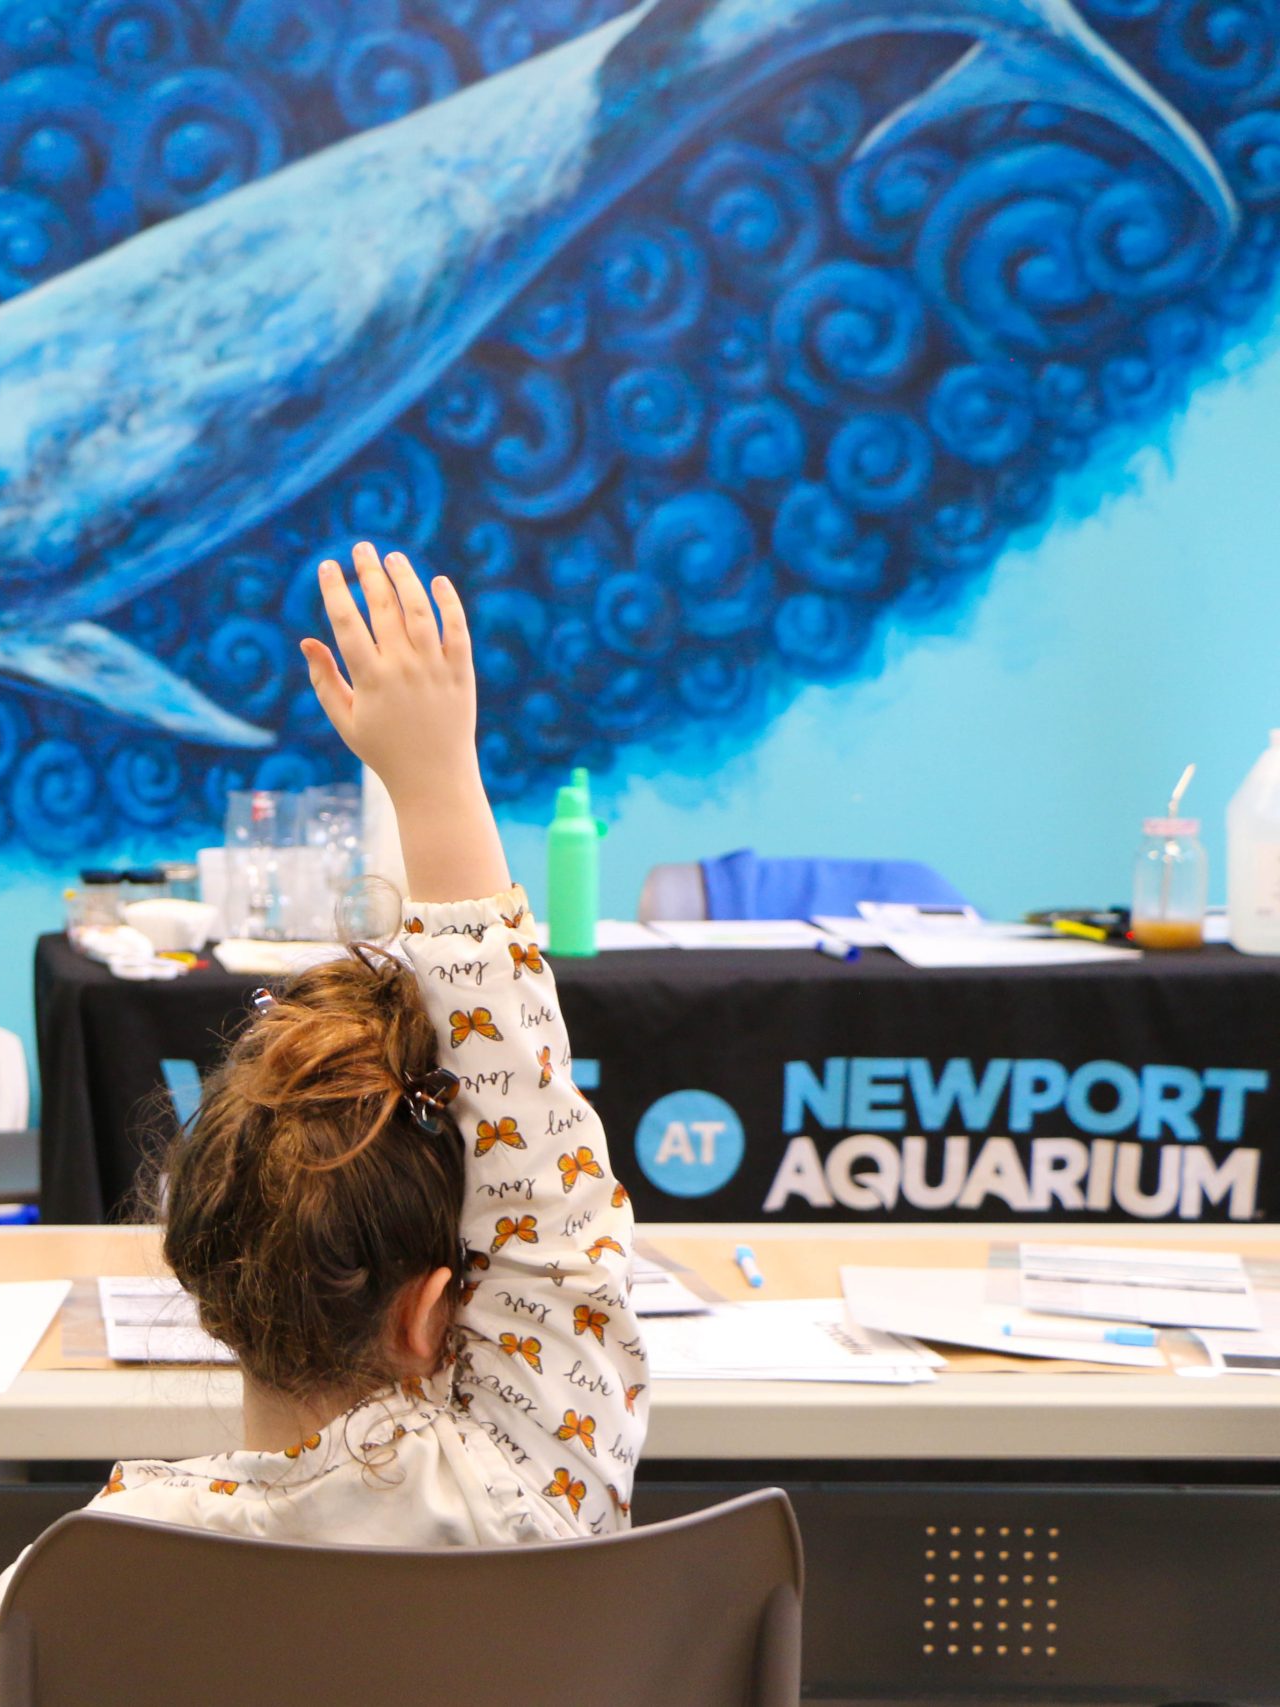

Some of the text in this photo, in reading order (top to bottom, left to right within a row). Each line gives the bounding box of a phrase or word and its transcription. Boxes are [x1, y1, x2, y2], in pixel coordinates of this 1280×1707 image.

[431, 923, 489, 943] ove
[428, 960, 489, 986] love
[520, 1003, 556, 1030] love
[459, 1069, 516, 1096] love
[783, 1057, 1268, 1141] NEWPORT
[544, 1108, 590, 1137] love
[654, 1121, 727, 1166] AT
[476, 1178, 536, 1200] love
[762, 1133, 1261, 1220] AQUARIUM
[560, 1209, 598, 1238] love
[494, 1291, 552, 1324] love
[617, 1337, 648, 1362] lov
[563, 1360, 614, 1397] love
[480, 1421, 532, 1465] love
